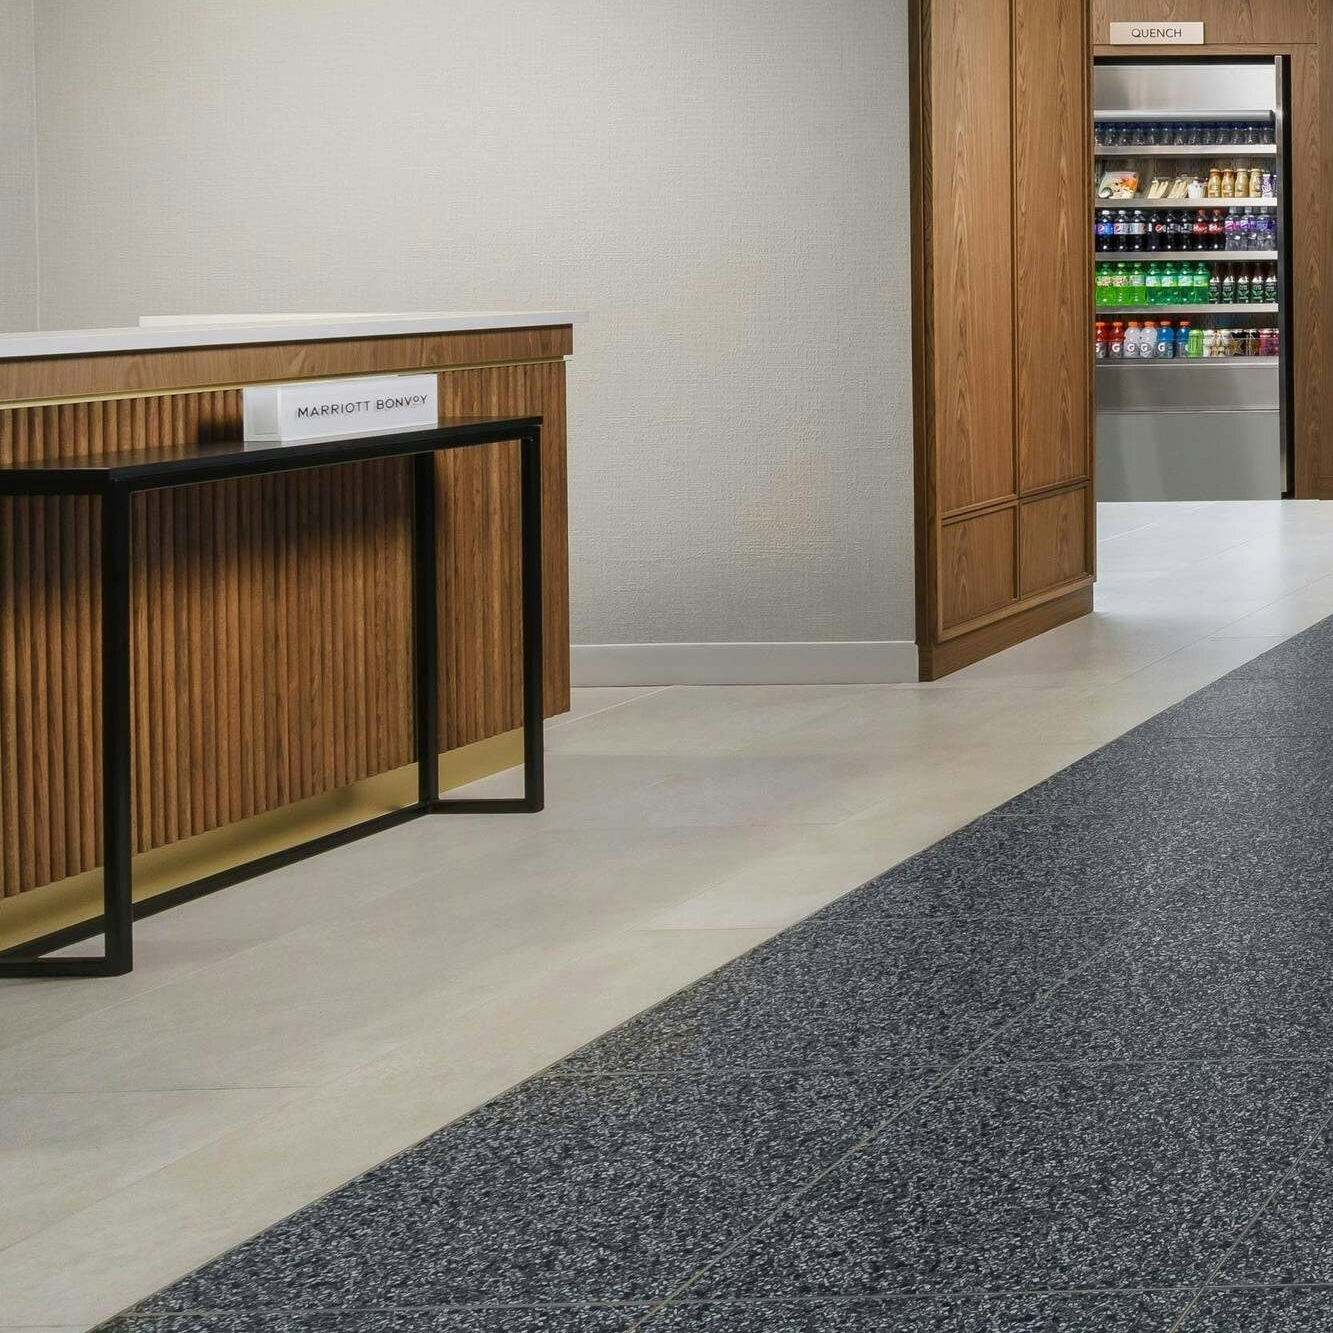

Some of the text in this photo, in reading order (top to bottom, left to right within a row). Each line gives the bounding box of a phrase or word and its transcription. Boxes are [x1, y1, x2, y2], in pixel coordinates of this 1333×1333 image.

[1131, 28, 1182, 39] QUENCH
[297, 394, 428, 418] MARRIOTT BONVOY
